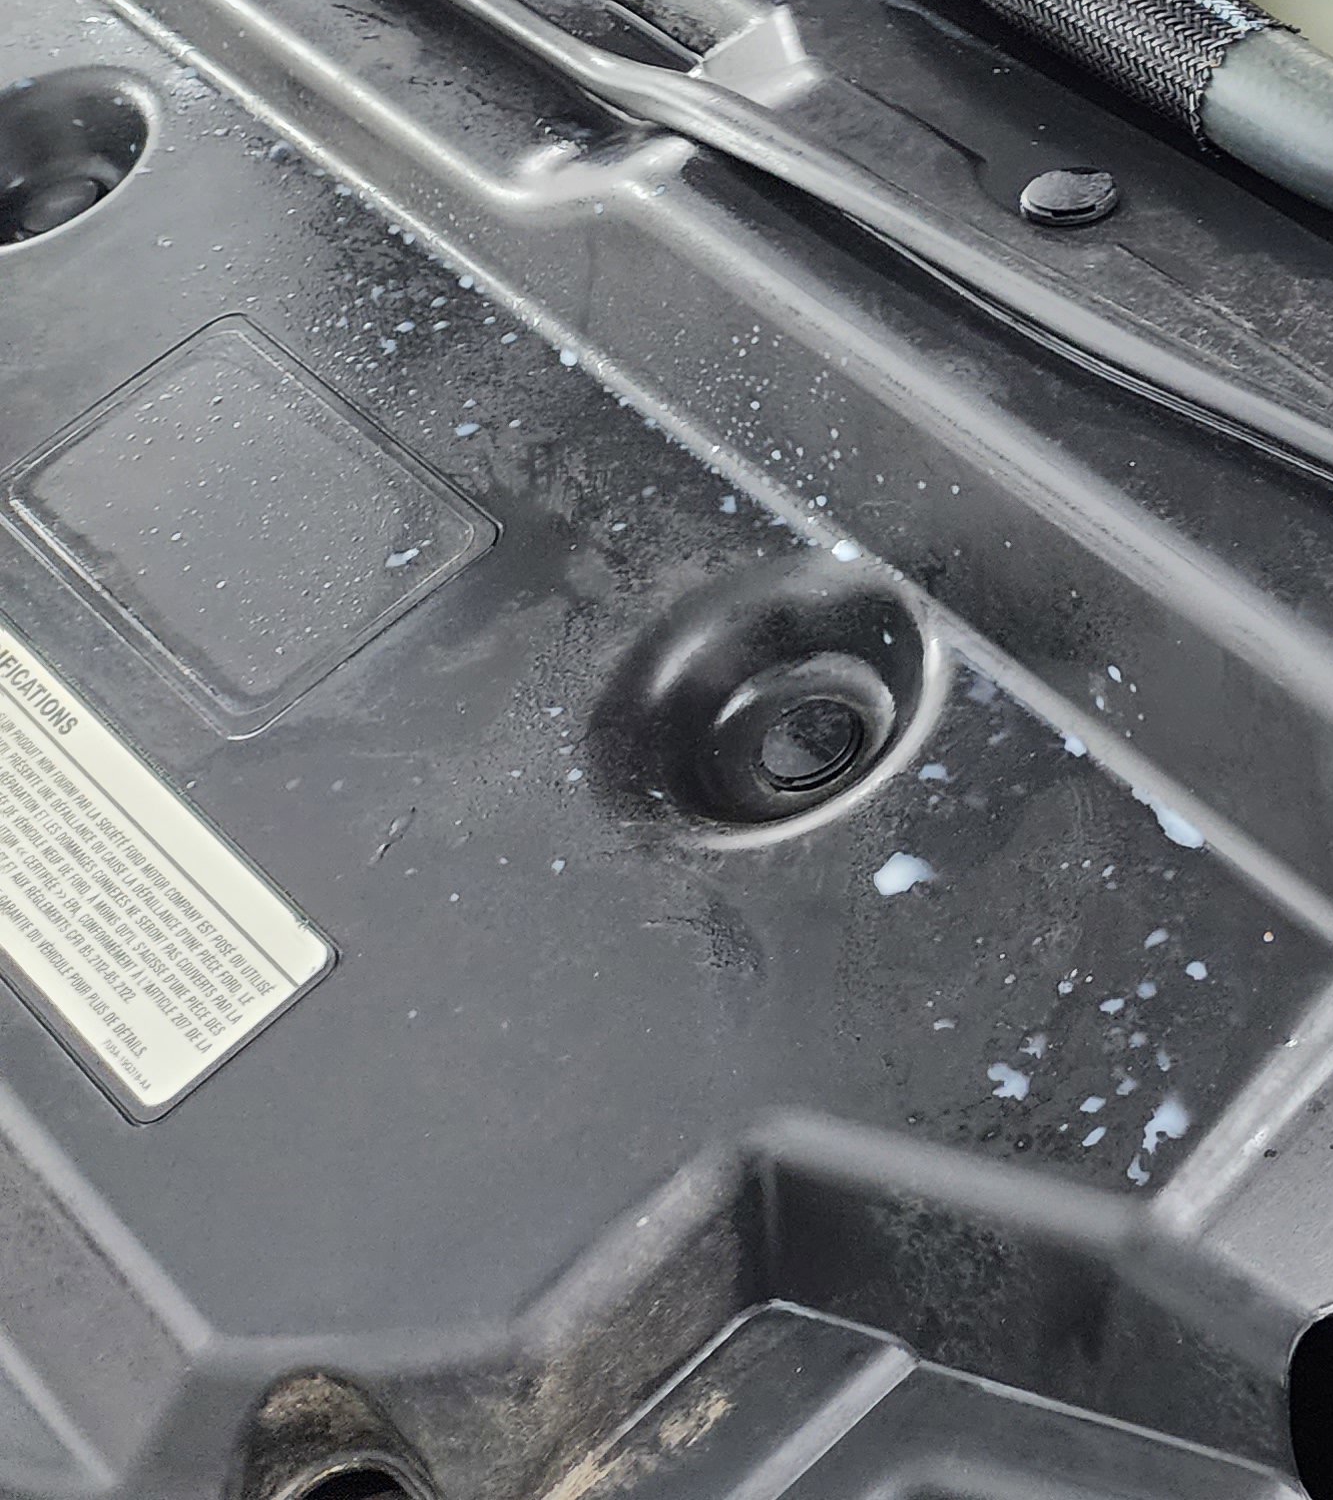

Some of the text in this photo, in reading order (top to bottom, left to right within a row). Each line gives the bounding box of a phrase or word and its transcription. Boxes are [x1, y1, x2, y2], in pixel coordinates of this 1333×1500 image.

[9, 728, 43, 760] PRODUIT
[35, 755, 57, 774] NON
[49, 770, 80, 797] FOURNI
[72, 793, 93, 811] PAR
[121, 843, 147, 867] FORD
[139, 863, 171, 891] MOTOR
[163, 887, 202, 923] COMPANY
[195, 920, 216, 938] EST
[9, 870, 31, 889] AUX
[63, 929, 85, 947] CFR
[36, 784, 56, 801] UNE
[99, 850, 128, 876] CAUSE
[213, 970, 244, 997] FORD,
[41, 818, 62, 835] LES
[54, 831, 98, 873] DOMMAGES
[90, 869, 131, 908] CONNEXES
[134, 915, 168, 946] SERONT
[160, 942, 182, 961] PAS
[174, 957, 217, 998] COUVERTS
[209, 994, 232, 1014] PAR
[40, 845, 64, 866] NEUF
[92, 900, 121, 926] MOINS
[203, 1017, 225, 1037] DES
[65, 972, 91, 996] POUR
[84, 992, 109, 1016] PLUS
[170, 1012, 191, 1031] 207
